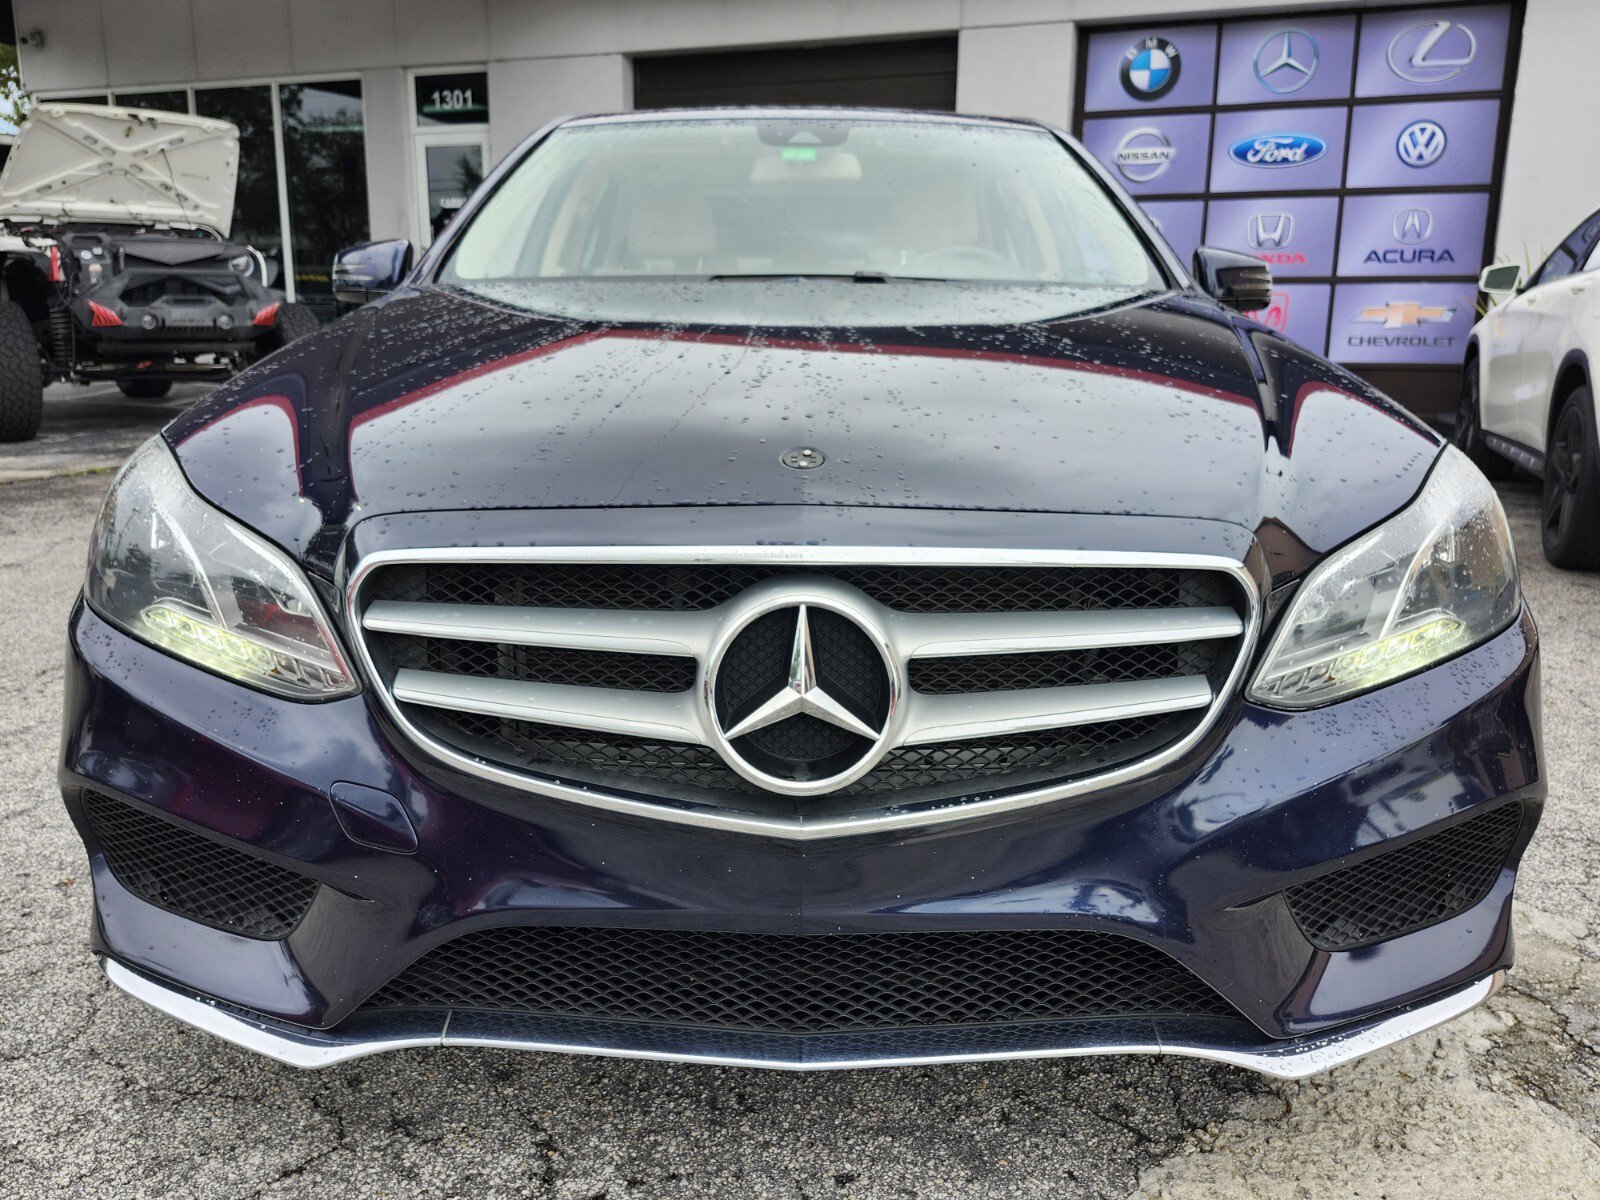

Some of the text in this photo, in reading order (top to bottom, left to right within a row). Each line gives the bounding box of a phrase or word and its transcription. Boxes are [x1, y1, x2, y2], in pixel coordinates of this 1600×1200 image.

[1125, 38, 1178, 60] BMW
[431, 88, 473, 110] 1301
[1117, 152, 1170, 162] NISSAN
[1247, 136, 1309, 163] Ford
[1255, 252, 1308, 265] NDA
[1363, 249, 1456, 264] ACURA
[1347, 335, 1456, 347] CHEVROLET
